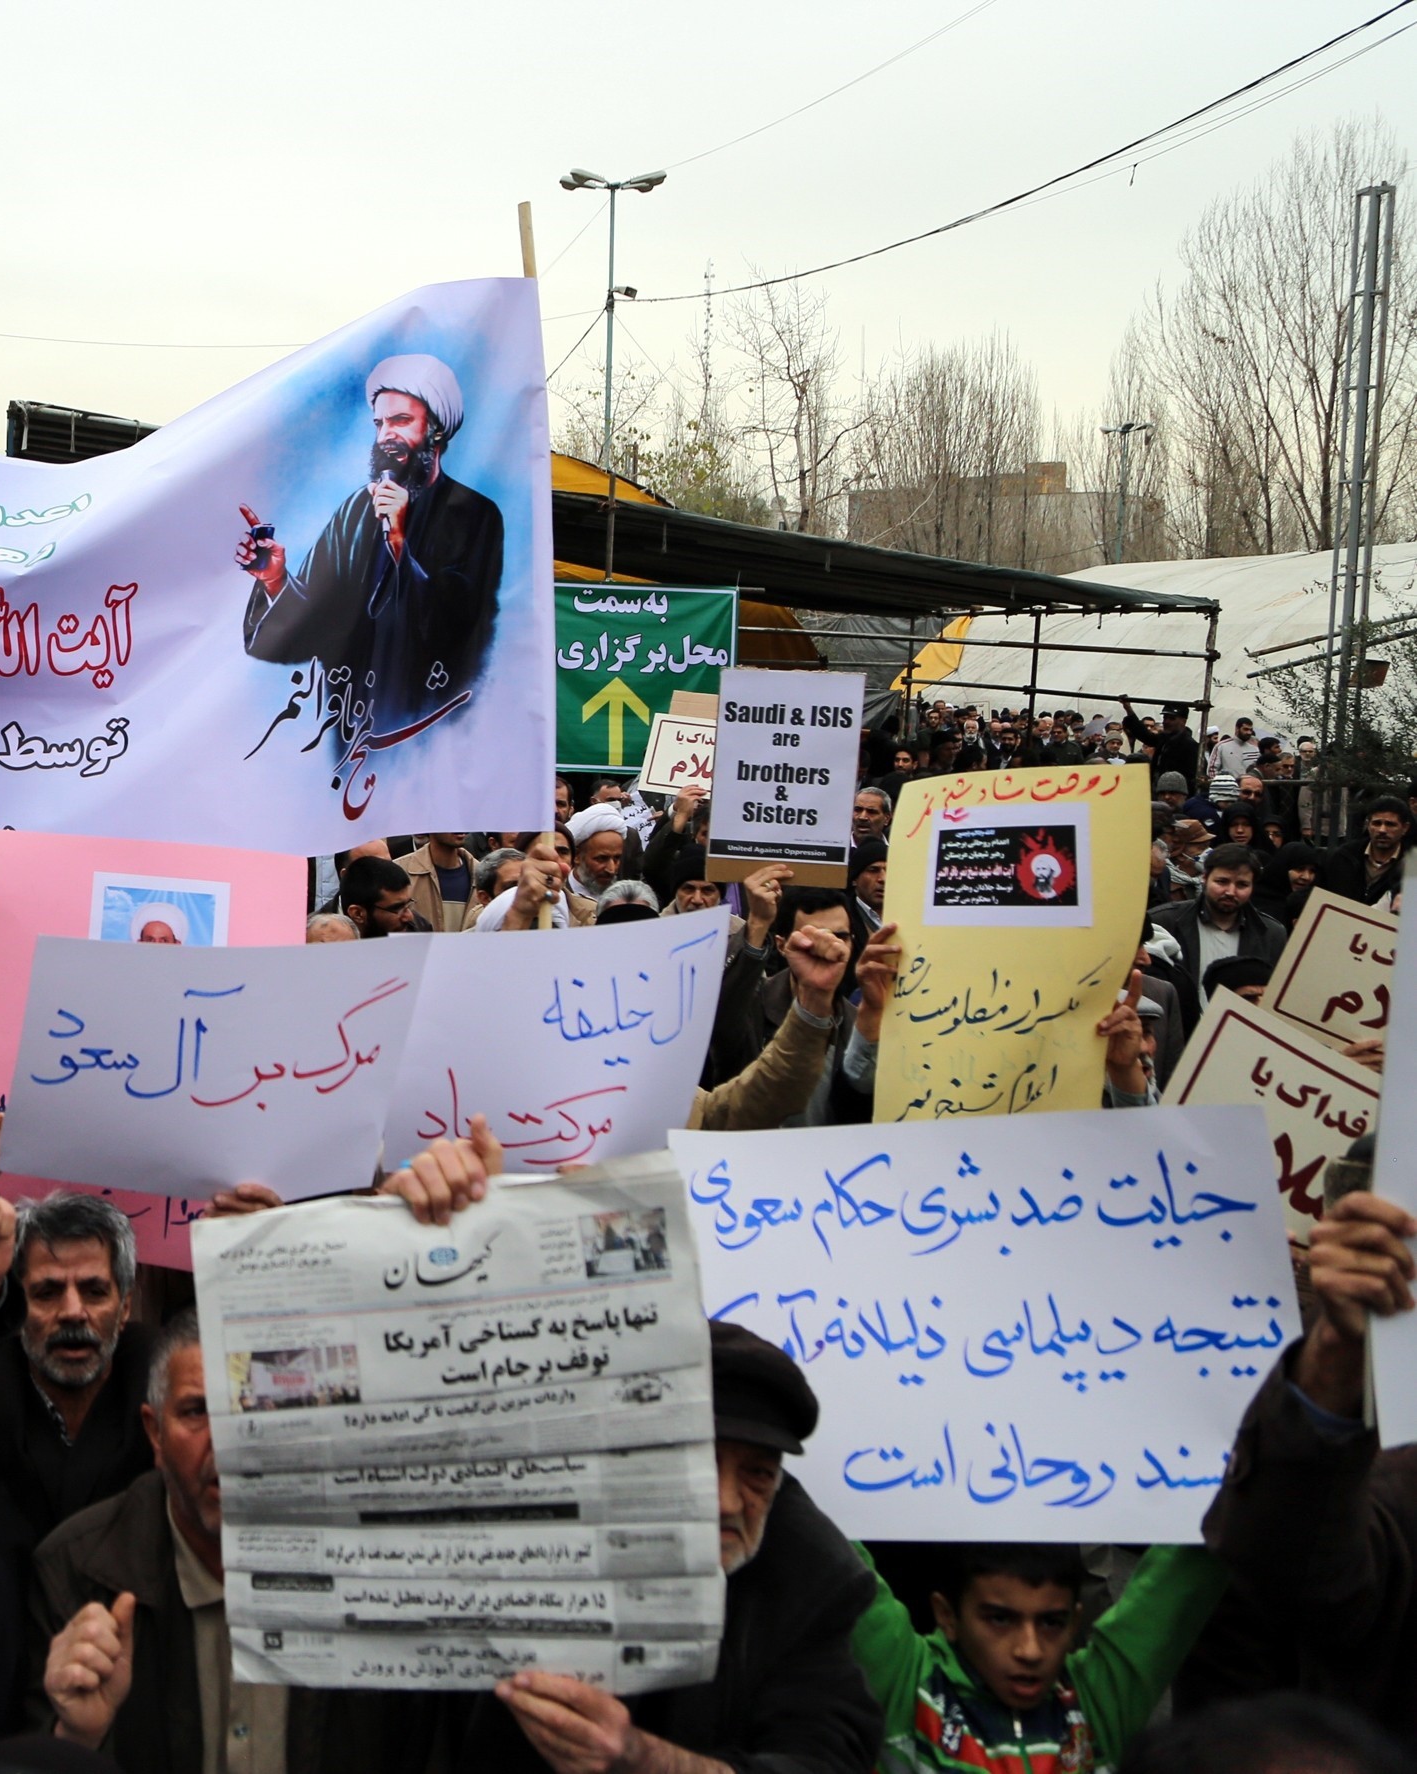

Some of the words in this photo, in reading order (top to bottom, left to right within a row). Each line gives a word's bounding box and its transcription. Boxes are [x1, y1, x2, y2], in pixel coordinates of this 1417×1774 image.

[47, 581, 138, 689] آیت
[686, 733, 716, 748] داک
[724, 701, 786, 726] Saudi
[790, 708, 805, 726] &
[810, 706, 853, 728] ISIS
[772, 732, 800, 748] are
[670, 752, 714, 782] لام
[737, 760, 830, 786] brothers
[775, 785, 789, 802] &
[742, 801, 818, 827] Sisters
[727, 844, 753, 853] United
[754, 846, 783, 856] Against
[784, 848, 827, 857] Oppression
[1349, 933, 1368, 962] یا
[647, 928, 720, 1045] آل
[124, 983, 246, 1100] آل
[291, 976, 410, 1094] مرگ
[542, 970, 653, 1067] خلیفه
[30, 1008, 141, 1086] سعود
[191, 1060, 287, 1111] بر
[1250, 1056, 1273, 1097] یا
[1276, 1081, 1370, 1138] فداک
[690, 1159, 804, 1251] سعودی
[812, 1153, 896, 1262] حکام
[901, 1151, 1012, 1257] بشری
[1011, 1167, 1083, 1226] ضد
[1097, 1150, 1258, 1249] جنایت
[384, 1325, 452, 1358] آمریکا
[548, 1320, 568, 1342] به
[571, 1308, 620, 1341] پاسخ
[624, 1303, 659, 1333] تنها
[824, 1295, 948, 1386] ذلیلانه
[1153, 1295, 1284, 1378] نتیجه
[440, 1360, 488, 1386] است
[556, 1346, 611, 1377] توقف
[843, 1420, 958, 1492] است
[966, 1422, 1117, 1508] روحانی
